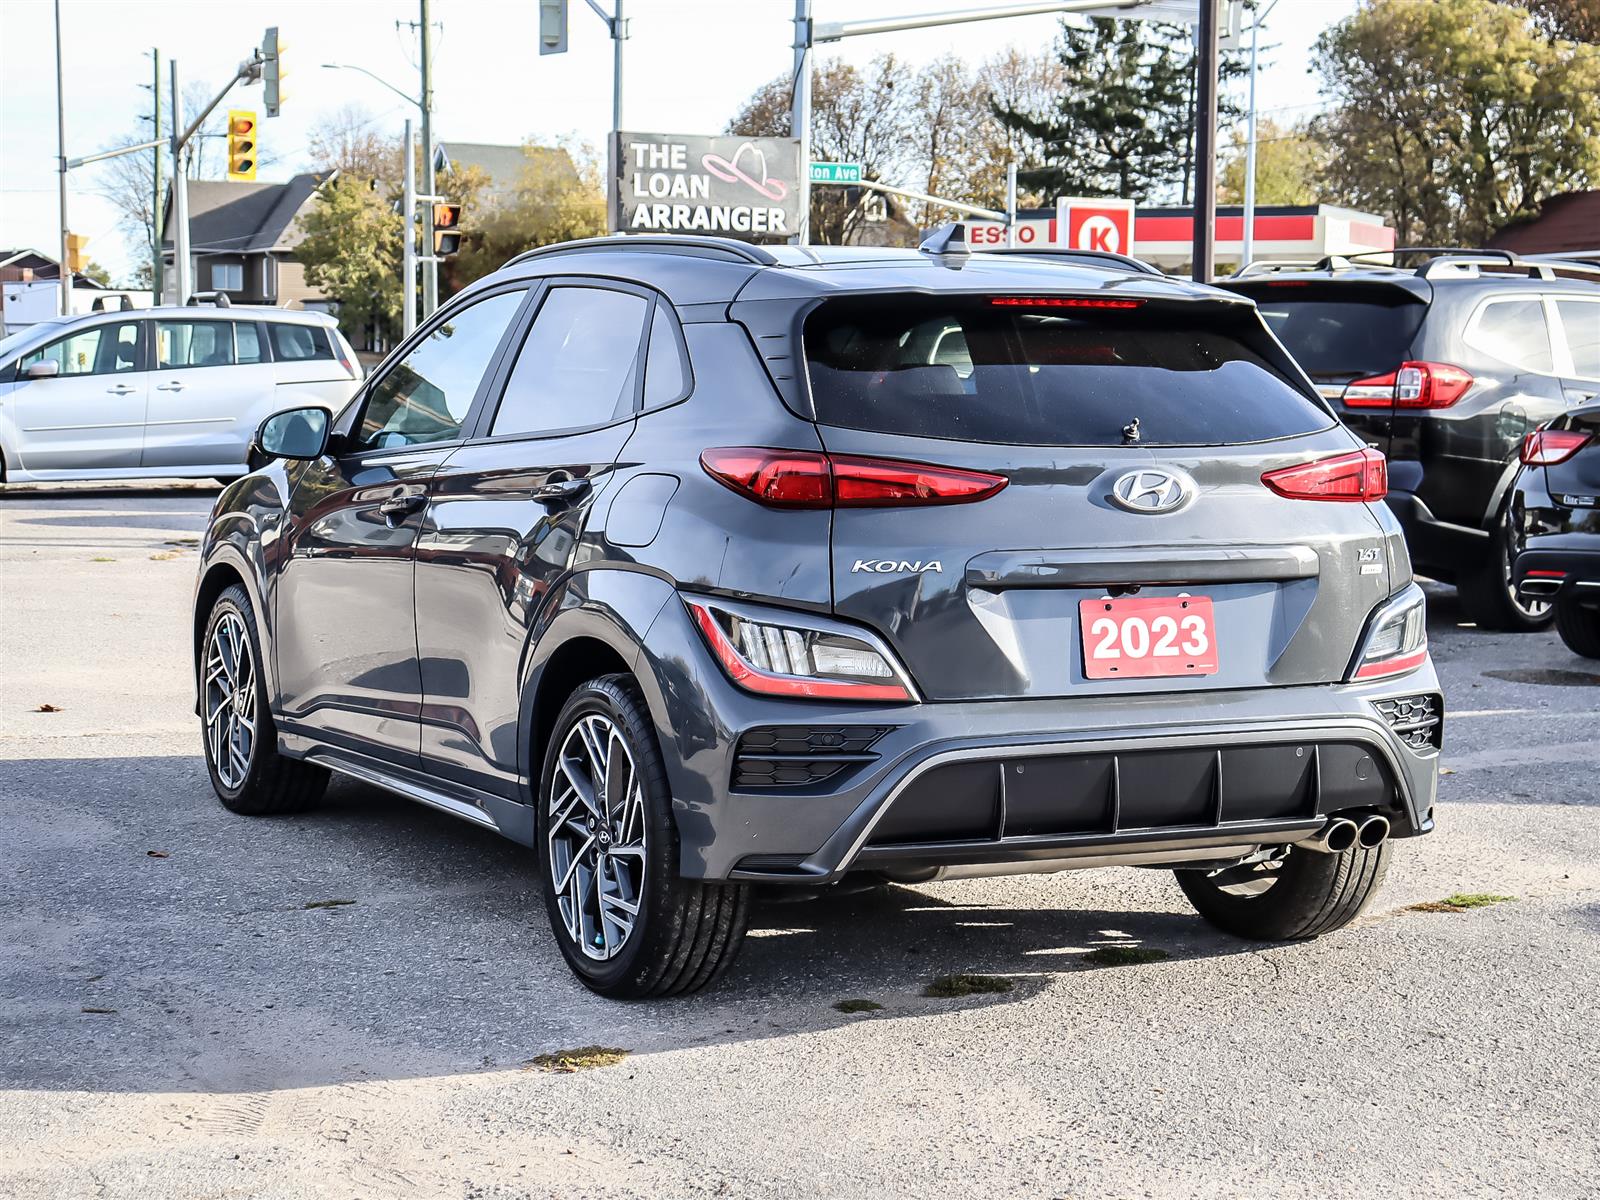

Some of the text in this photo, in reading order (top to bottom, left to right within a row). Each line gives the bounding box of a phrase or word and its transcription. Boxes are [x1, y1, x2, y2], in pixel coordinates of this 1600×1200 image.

[630, 142, 687, 170] THE
[633, 172, 710, 199] LOAN
[835, 166, 858, 180] Ave
[631, 203, 787, 232] ARRANGER
[1090, 227, 1112, 252] K
[851, 559, 943, 573] KONA
[1091, 615, 1209, 659] 2023
